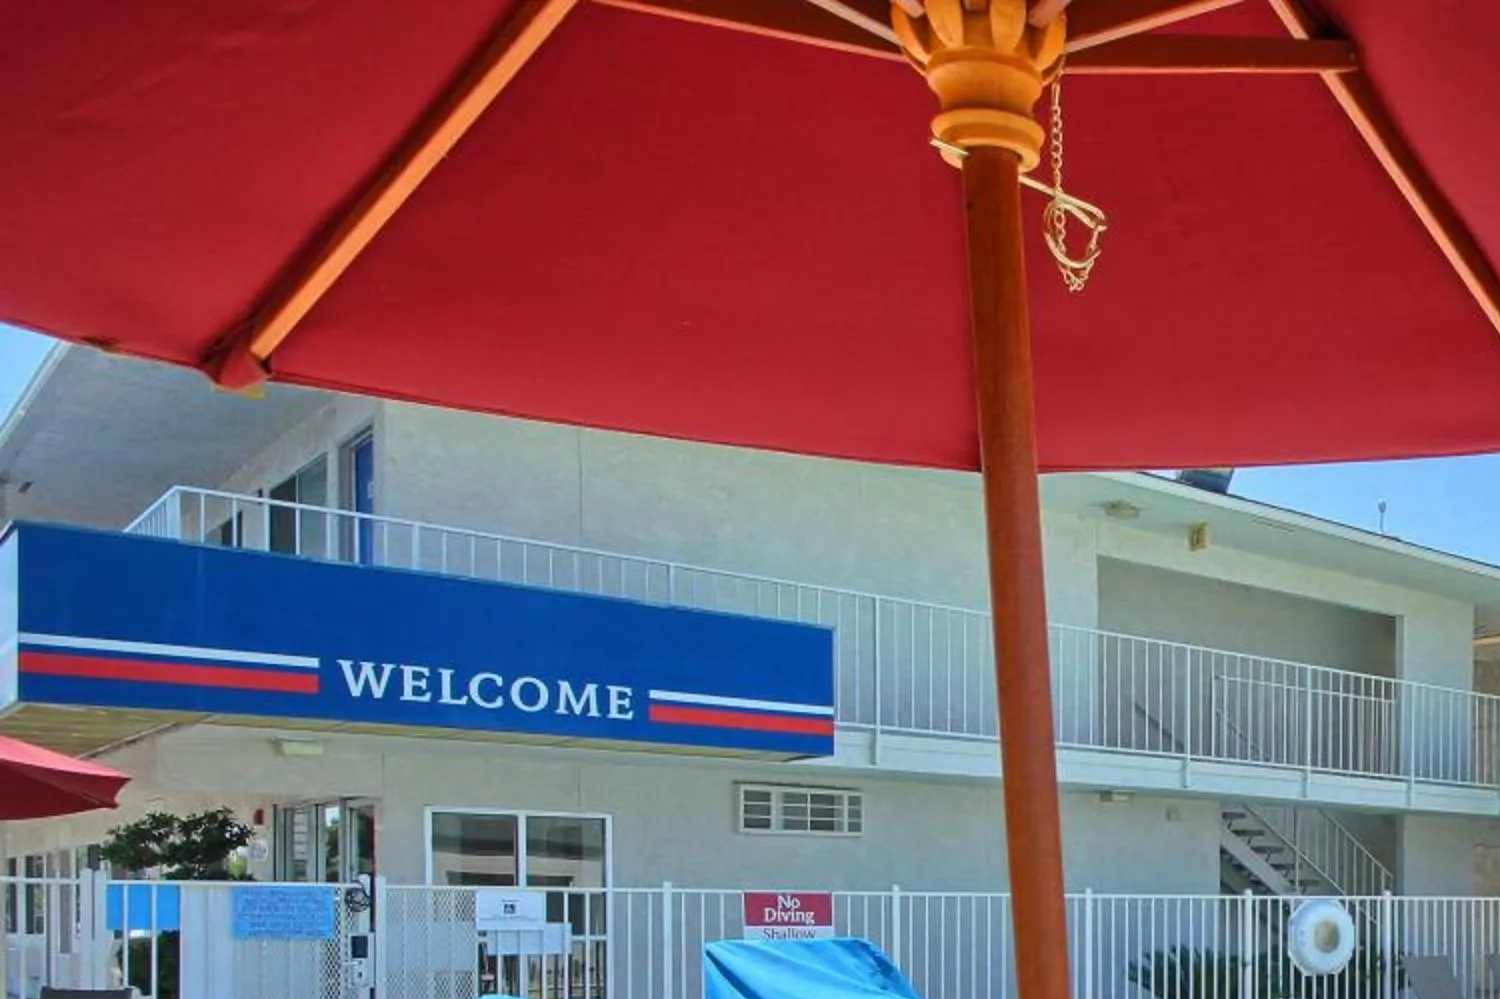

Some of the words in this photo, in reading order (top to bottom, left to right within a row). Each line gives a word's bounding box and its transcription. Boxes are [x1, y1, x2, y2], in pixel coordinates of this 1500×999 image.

[336, 659, 634, 721] WELCOME
[777, 894, 801, 910] No
[763, 907, 816, 924] Diving
